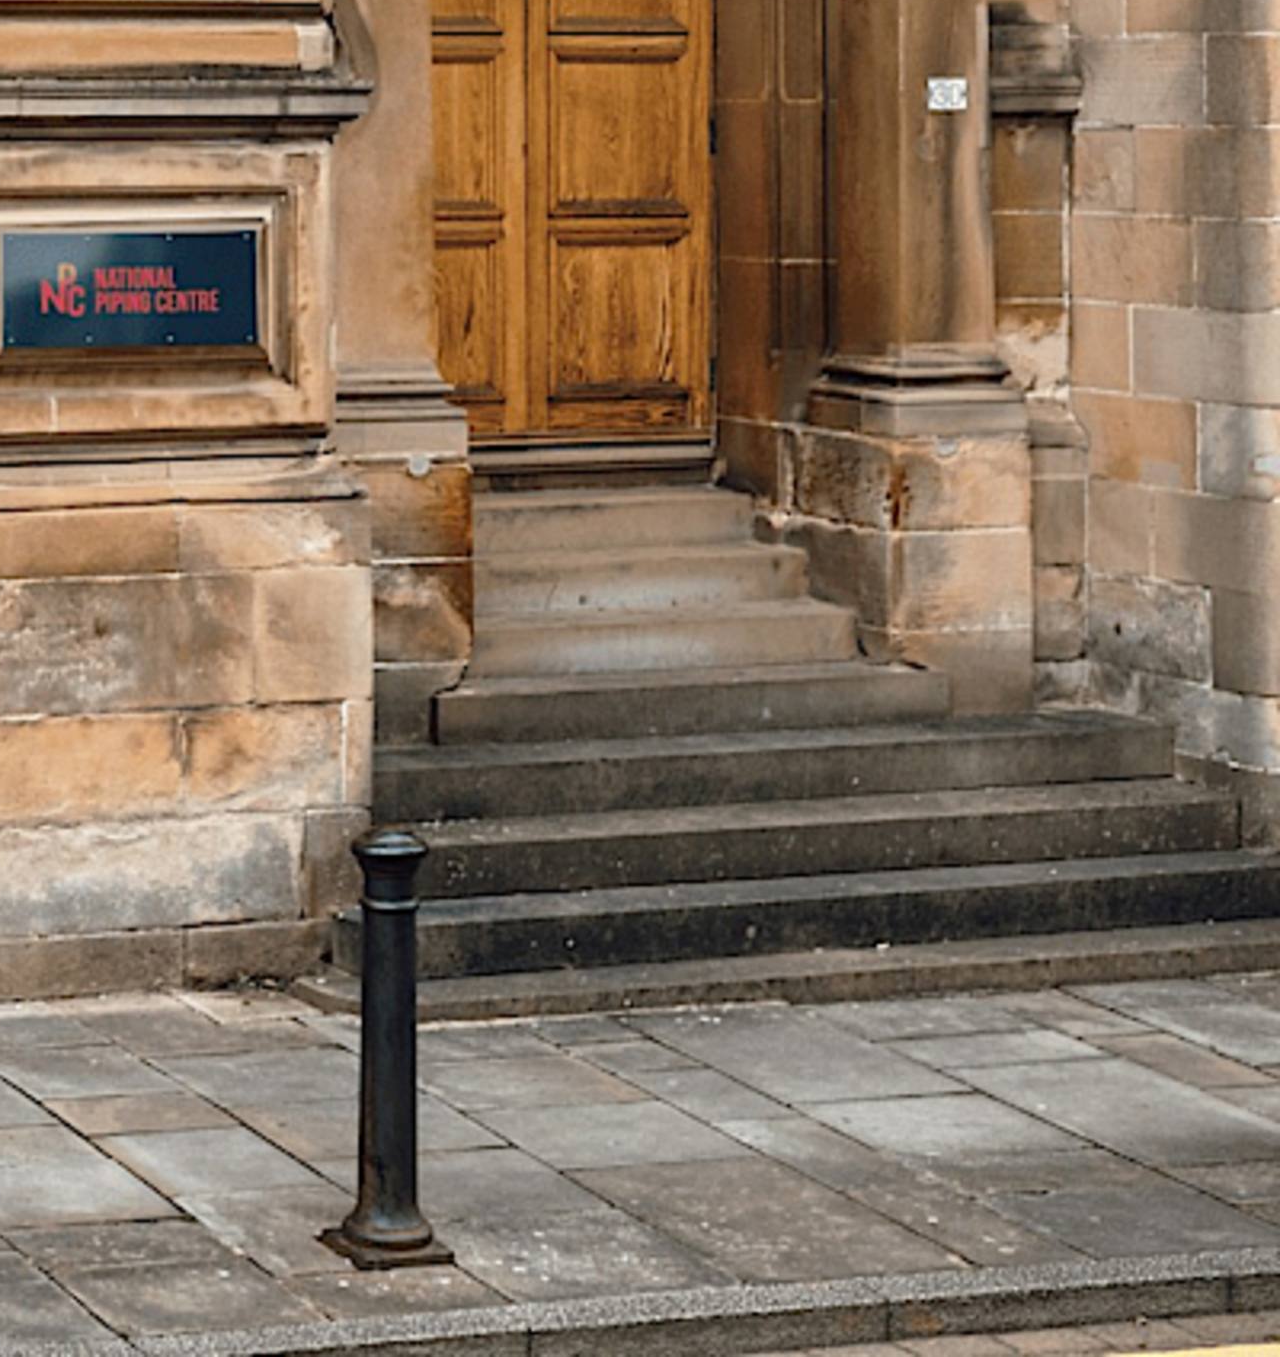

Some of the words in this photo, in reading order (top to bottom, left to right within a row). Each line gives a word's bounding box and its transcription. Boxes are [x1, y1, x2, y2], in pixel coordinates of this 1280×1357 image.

[94, 266, 176, 289] NATIONAL
[94, 290, 151, 314] PIPING
[155, 288, 220, 314] CENTRE
